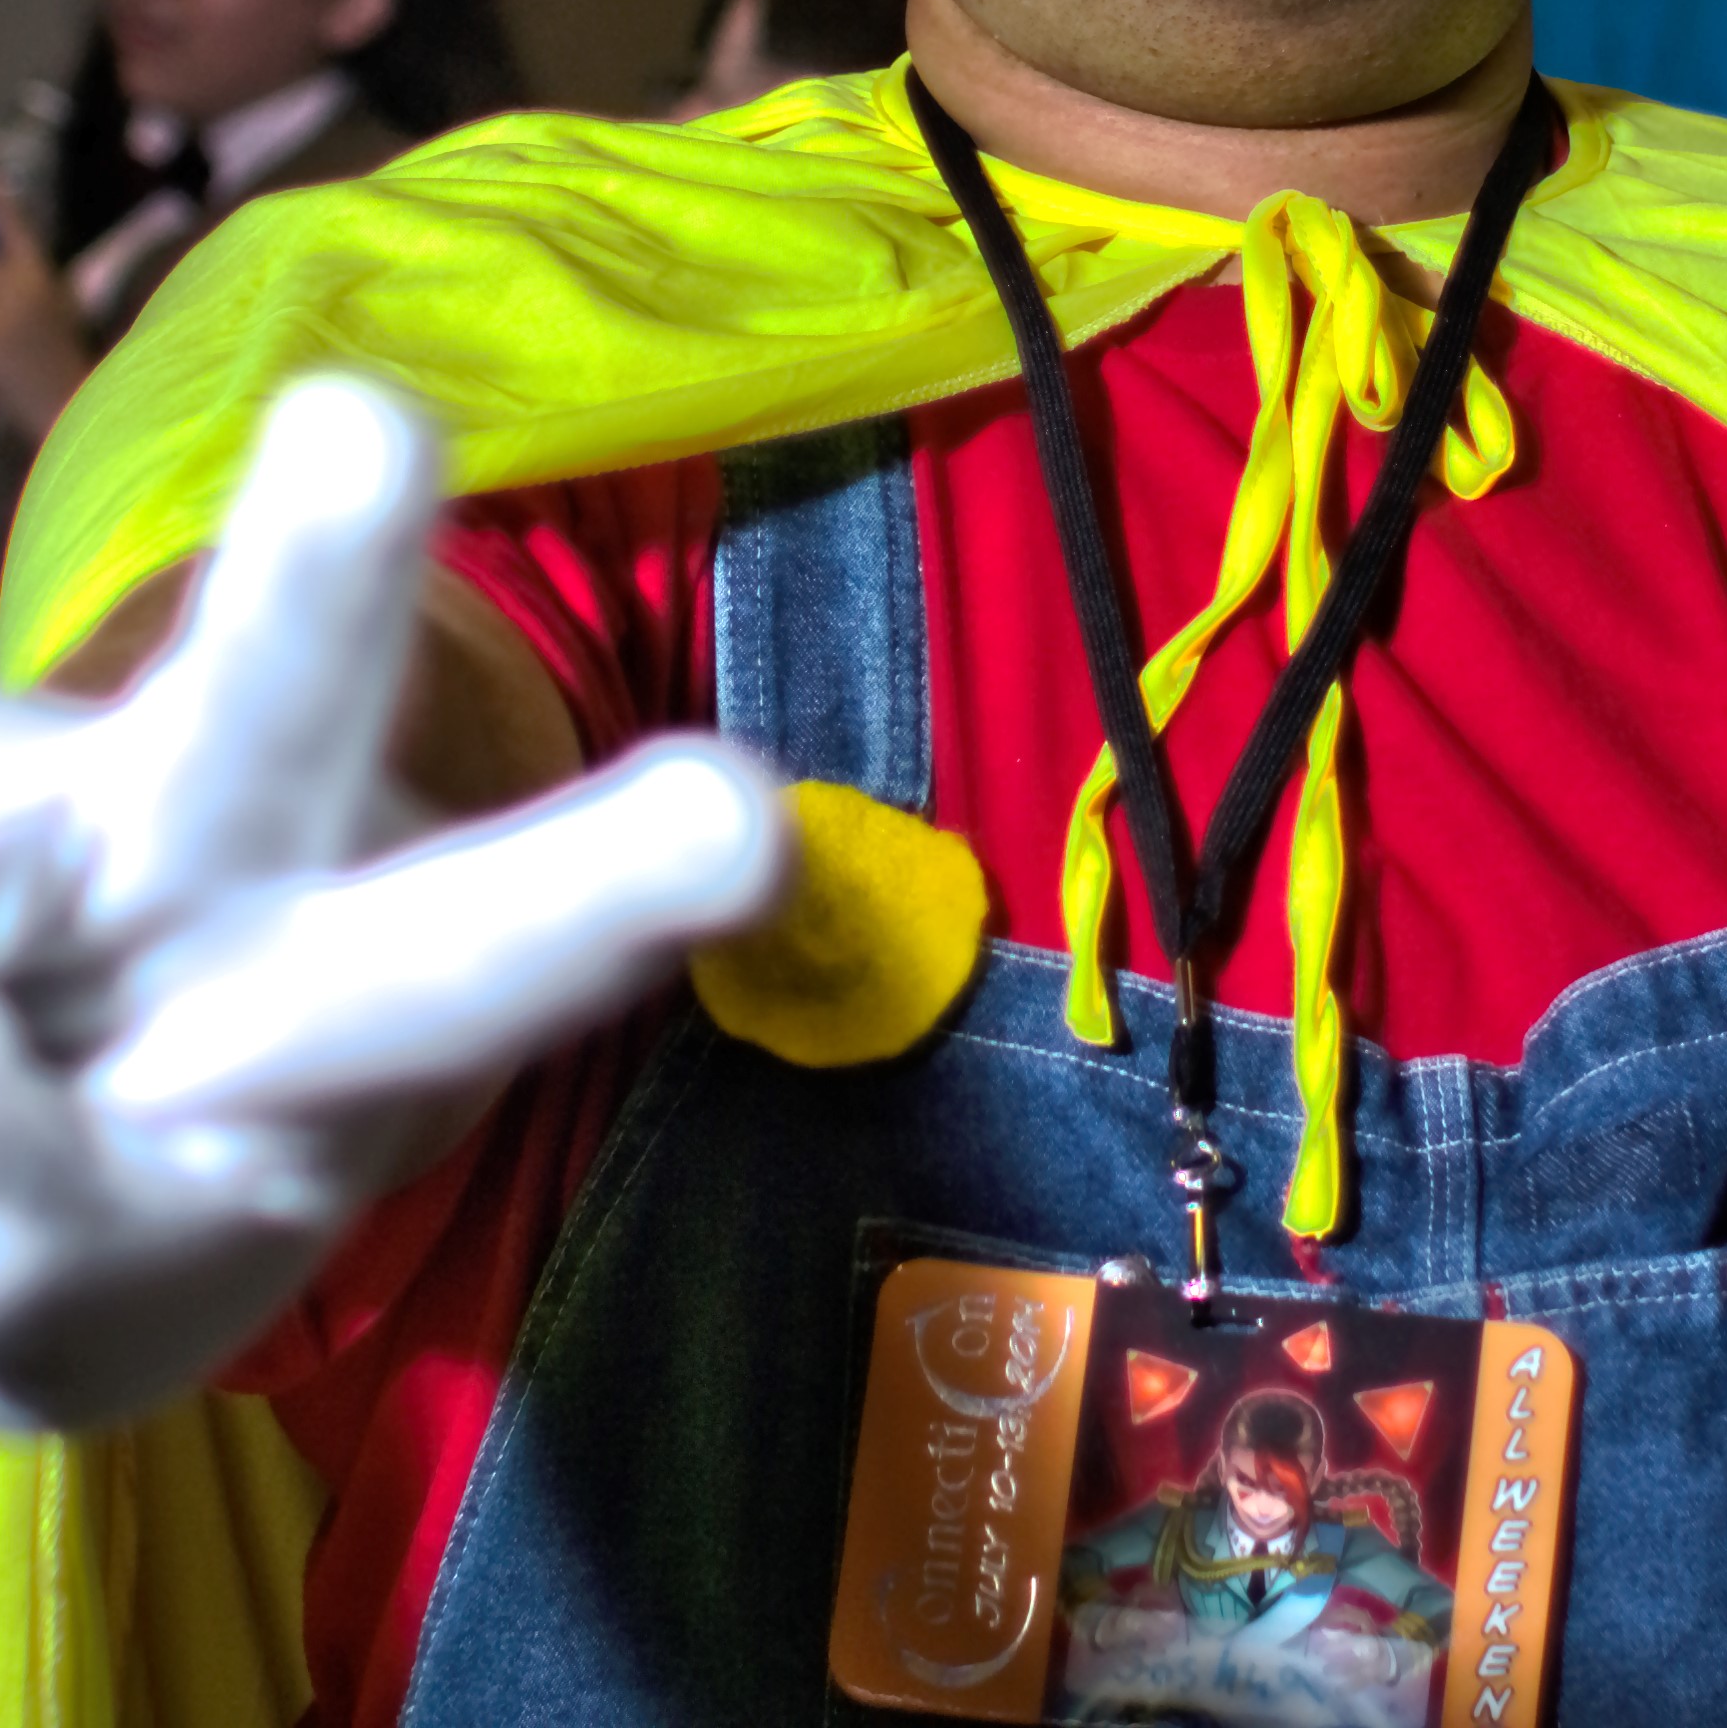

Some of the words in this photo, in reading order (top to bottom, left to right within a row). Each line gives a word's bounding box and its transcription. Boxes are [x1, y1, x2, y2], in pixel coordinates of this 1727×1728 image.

[974, 1523, 1010, 1629] JULY
[1005, 1296, 1045, 1394] 2014
[1472, 1477, 1540, 1723] WEEKEN
